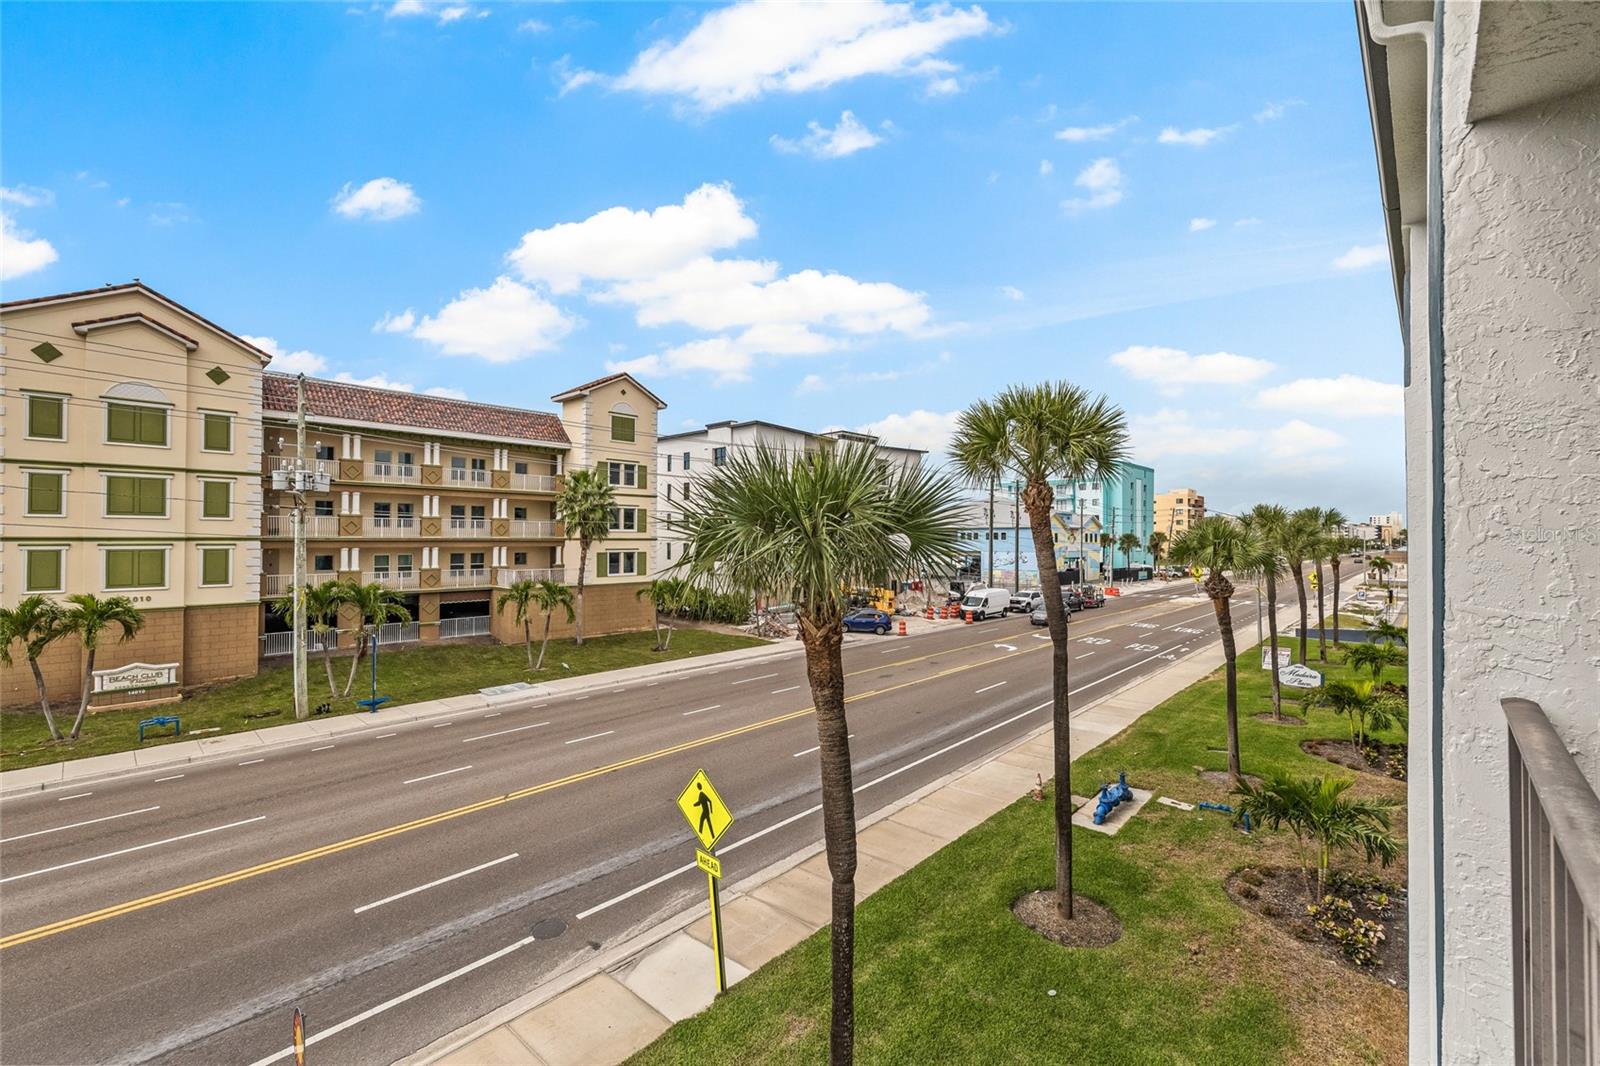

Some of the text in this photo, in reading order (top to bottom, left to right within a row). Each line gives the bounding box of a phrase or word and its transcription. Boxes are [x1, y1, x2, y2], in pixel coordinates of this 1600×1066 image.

[1124, 643, 1159, 652] PED
[108, 674, 139, 684] BEACH
[141, 671, 163, 680] CLUB
[699, 855, 719, 873] AHEAD
